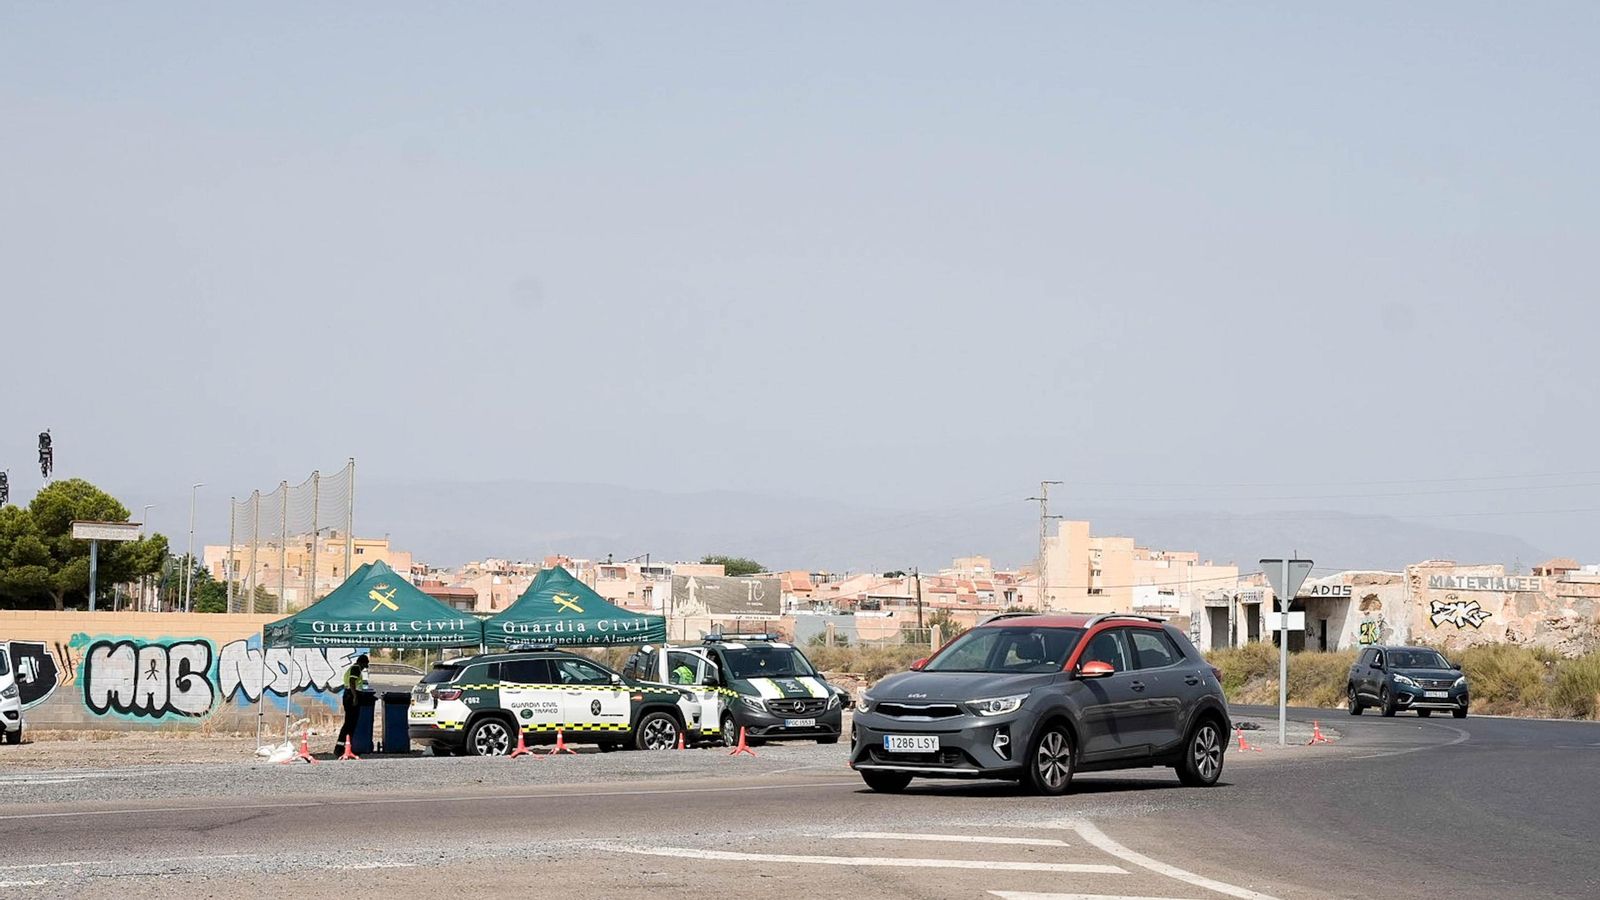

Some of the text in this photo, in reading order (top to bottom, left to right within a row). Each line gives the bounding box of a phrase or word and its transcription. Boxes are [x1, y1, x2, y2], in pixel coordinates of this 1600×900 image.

[1428, 575, 1540, 590] MATERIALES
[1311, 585, 1352, 596] ADOS
[312, 619, 465, 633] Guardia Civil
[503, 618, 649, 634] Guardia Civil
[313, 634, 395, 644] Comandancia
[399, 634, 412, 642] de
[586, 634, 599, 643] de
[891, 737, 936, 749] 1286 LSY
